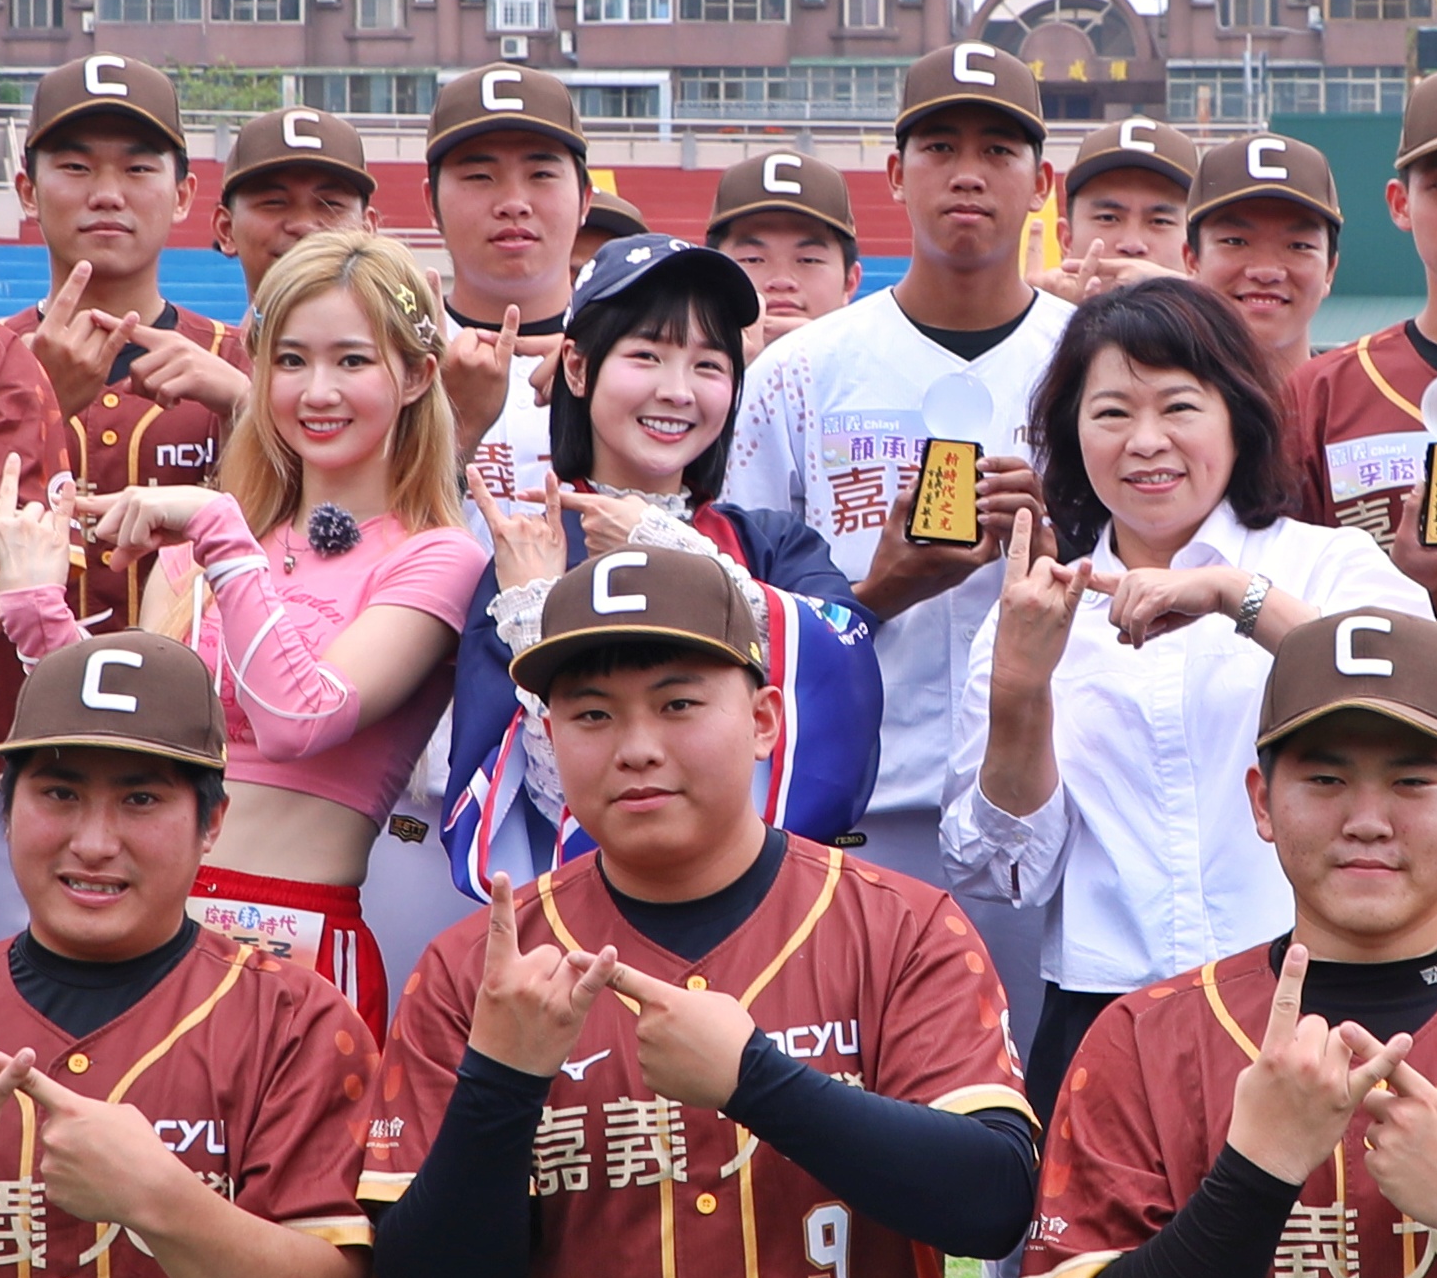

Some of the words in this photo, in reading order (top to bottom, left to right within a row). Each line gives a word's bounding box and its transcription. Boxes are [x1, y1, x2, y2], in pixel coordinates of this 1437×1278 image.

[85, 55, 128, 95] C
[952, 42, 996, 85] C
[482, 70, 524, 111] C
[283, 111, 322, 149] C
[1119, 118, 1155, 154] C
[763, 154, 802, 194] C
[1247, 138, 1288, 179] C
[593, 551, 648, 614] C
[1335, 615, 1393, 677] C
[81, 649, 143, 712] C
[204, 905, 298, 937] 綜藝新時代
